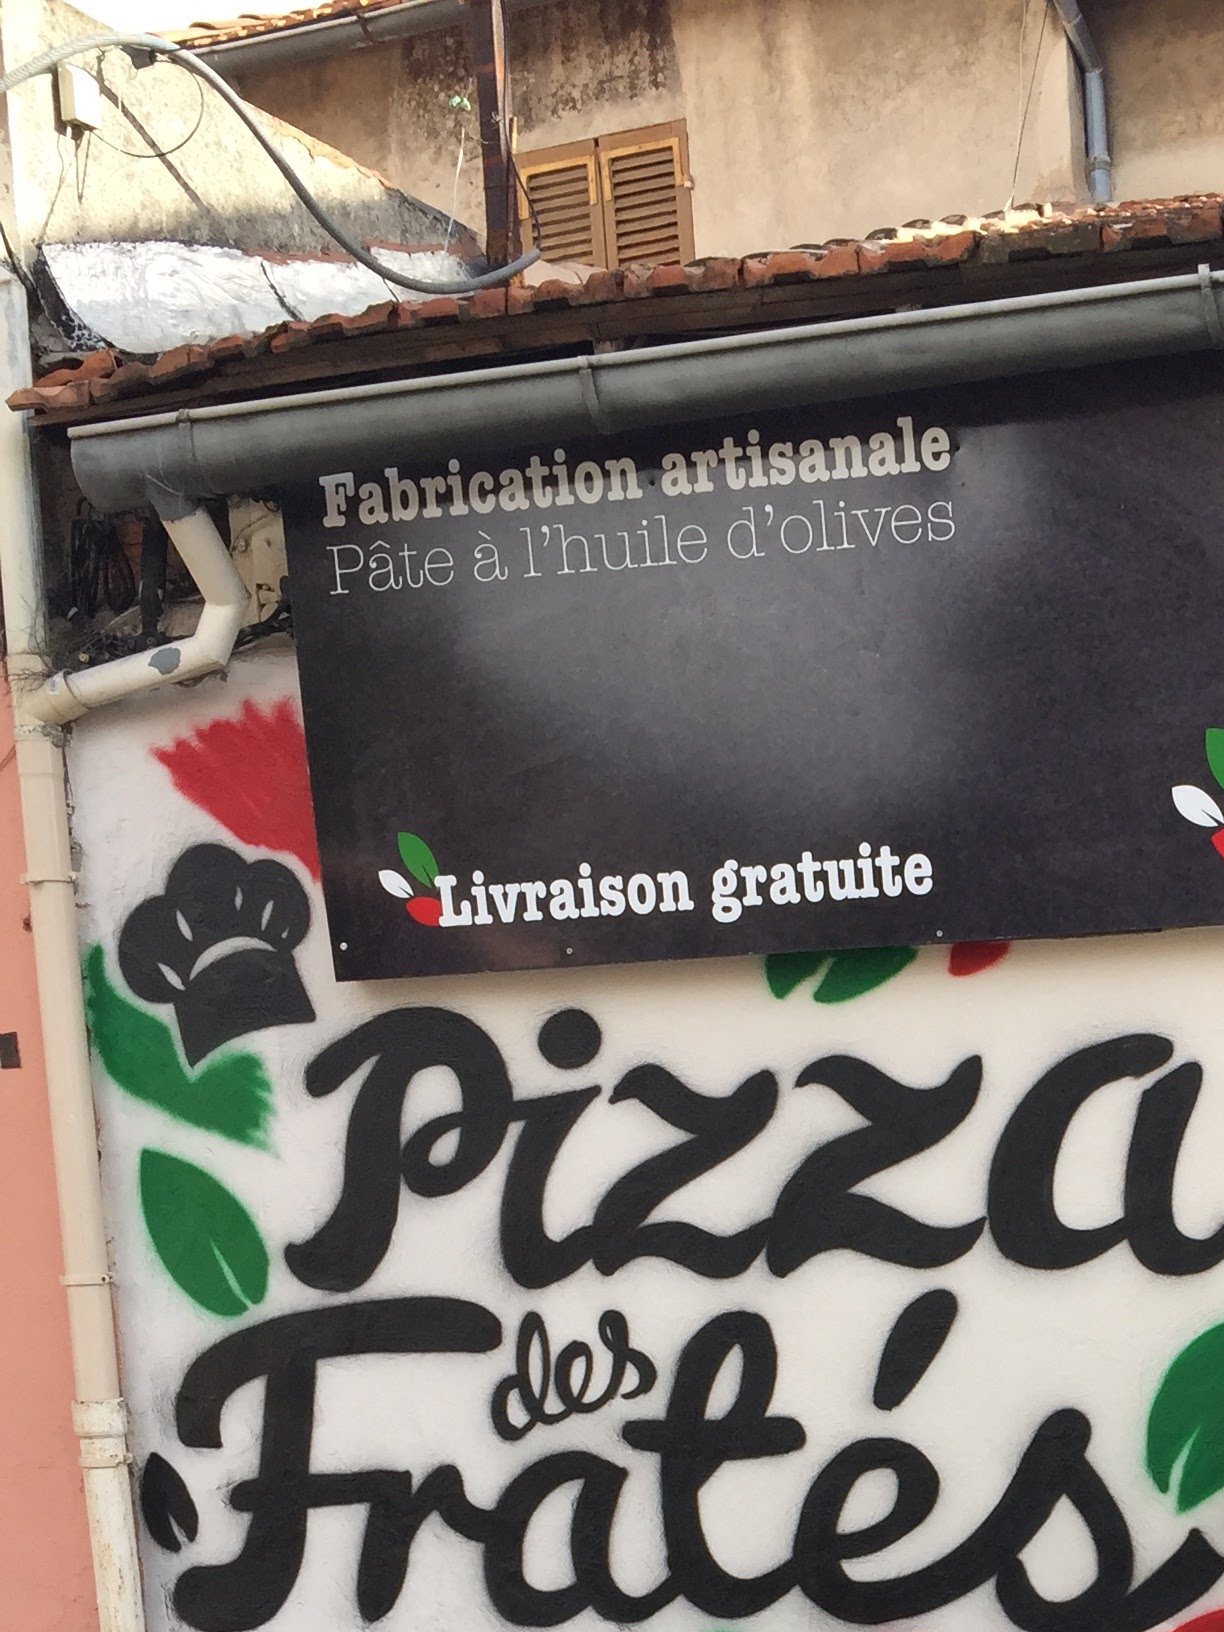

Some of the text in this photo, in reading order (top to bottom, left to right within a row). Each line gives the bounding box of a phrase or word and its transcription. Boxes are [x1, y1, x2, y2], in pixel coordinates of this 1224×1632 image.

[318, 415, 951, 528] Fabrication artisanale
[325, 499, 956, 596] Pâte à l'huile d'olives
[433, 841, 933, 928] Livraison gratuite
[490, 1309, 658, 1442] des
